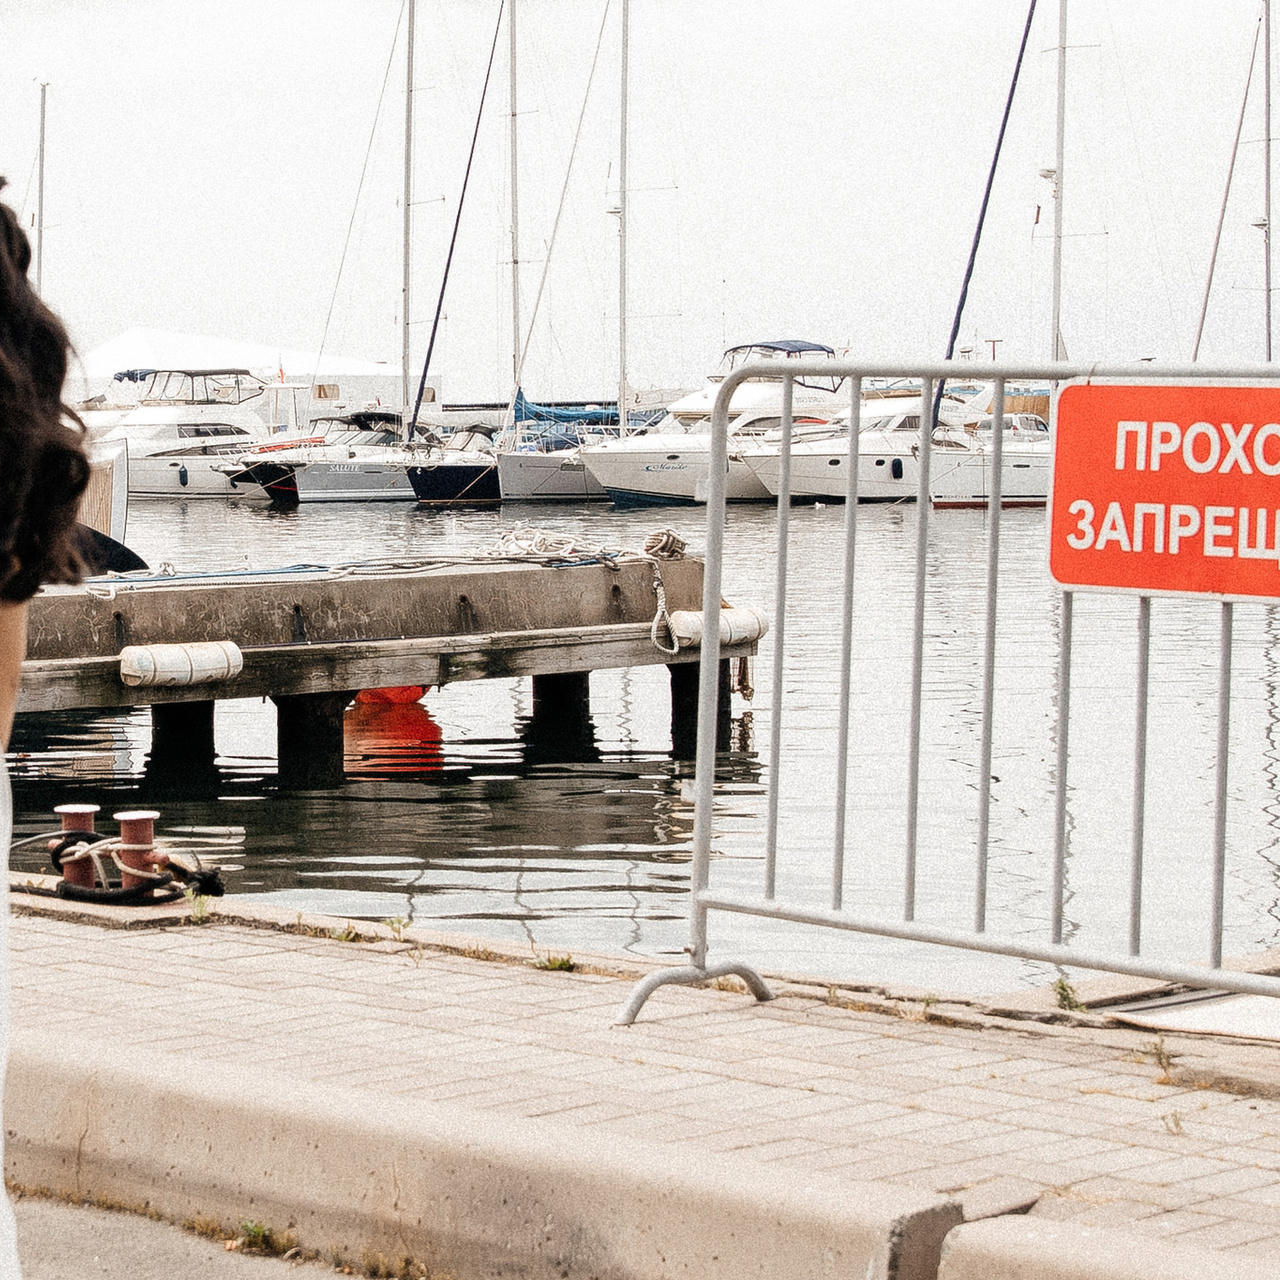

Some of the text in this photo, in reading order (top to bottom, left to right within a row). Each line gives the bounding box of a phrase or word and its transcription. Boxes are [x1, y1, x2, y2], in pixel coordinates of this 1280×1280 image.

[329, 464, 360, 472] SALUTE
[1115, 420, 1280, 476] ПРОХО
[1066, 499, 1280, 571] ЗАПРЕЩ
